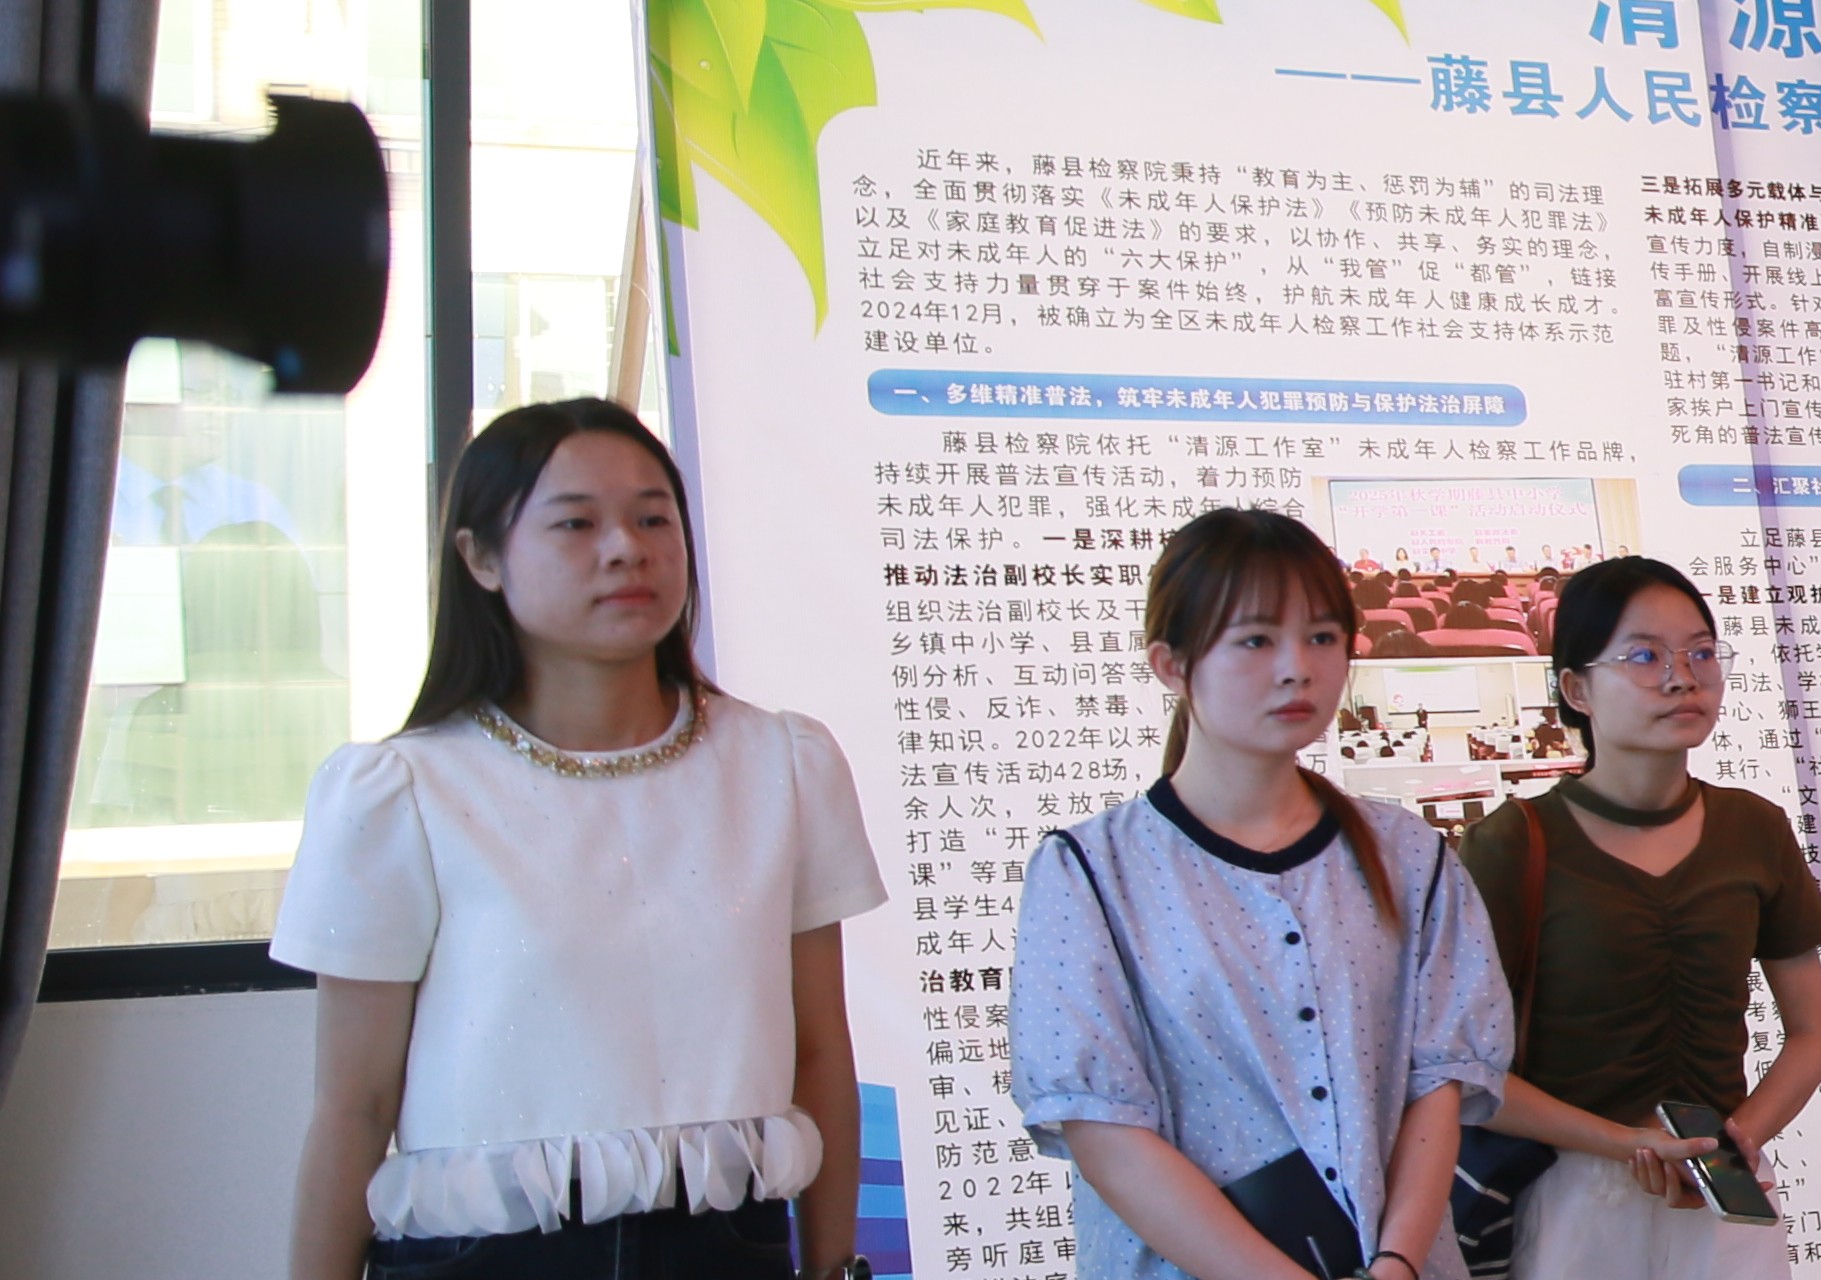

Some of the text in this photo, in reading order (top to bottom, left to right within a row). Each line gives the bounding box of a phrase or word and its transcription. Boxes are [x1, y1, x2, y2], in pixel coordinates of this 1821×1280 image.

[858, 268, 1620, 316] 社会支持力量贯穿于案件始终，护航未成年人健康成长成才。
[861, 299, 1614, 344] 2024年12月，被确立为全区未成年人检察工作社会支持体系示范
[864, 330, 997, 355] 建设单位。
[893, 382, 1505, 416] 一、多维精准普法，筑牢未成年人犯罪预防与保护法治屏障
[874, 461, 1303, 489] 持续开展普法宣传活动，着力预防
[884, 564, 1155, 587] 推动法治副校长实职
[892, 661, 1153, 688] 例分析、互动问答等
[898, 725, 1161, 753] 律知识。2022年以来
[901, 758, 1142, 787] 法宣传活动428场，
[904, 790, 1148, 820] 余人次，发放宣
[916, 927, 1016, 956] 成年人
[920, 967, 1014, 994] 治教育
[924, 1004, 1008, 1031] 性侵案
[926, 1037, 1010, 1066] 偏远地
[936, 1137, 1034, 1170] 防范意
[946, 1237, 1075, 1272] 旁听庭审
